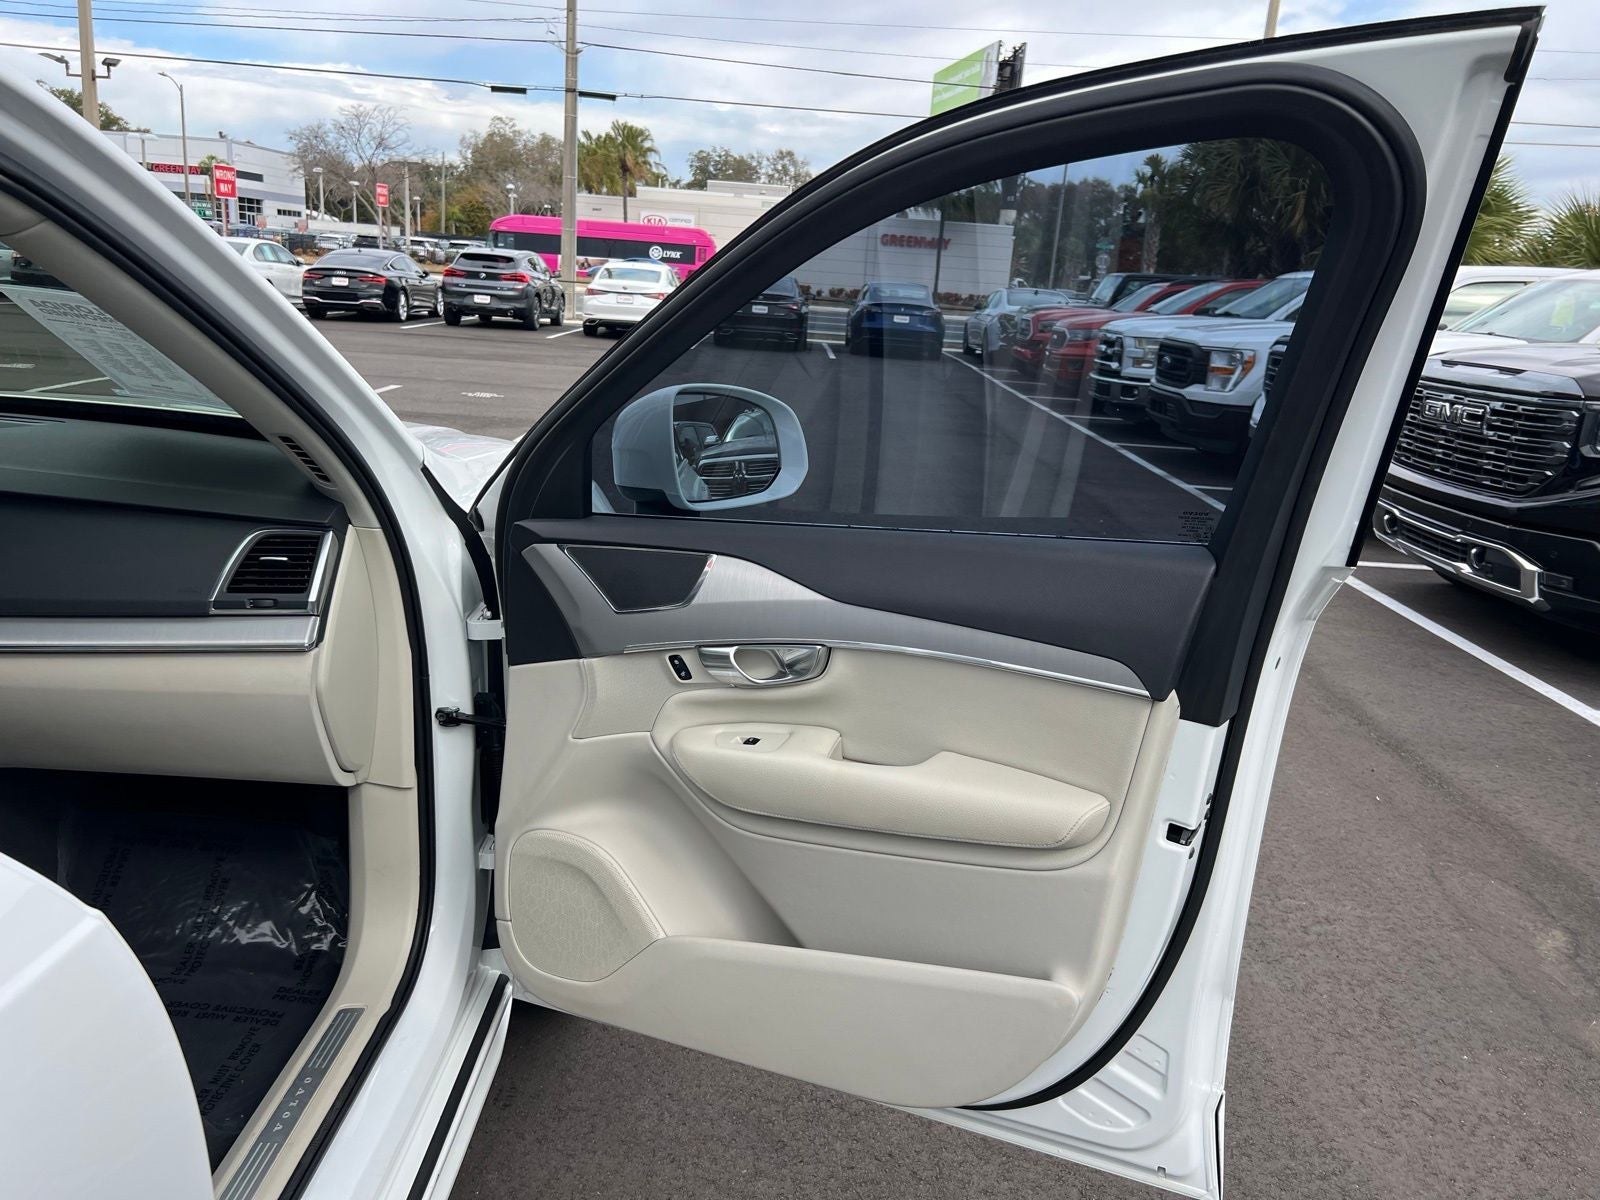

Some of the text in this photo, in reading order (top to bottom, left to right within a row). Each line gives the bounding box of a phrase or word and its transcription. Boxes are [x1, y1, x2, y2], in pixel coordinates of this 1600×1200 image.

[215, 169, 235, 182] WRONG
[219, 182, 232, 194] WAY
[646, 217, 664, 226] KIA
[662, 250, 682, 259] LYNX
[1422, 398, 1485, 427] GMC
[272, 1076, 312, 1133] VOLVO
